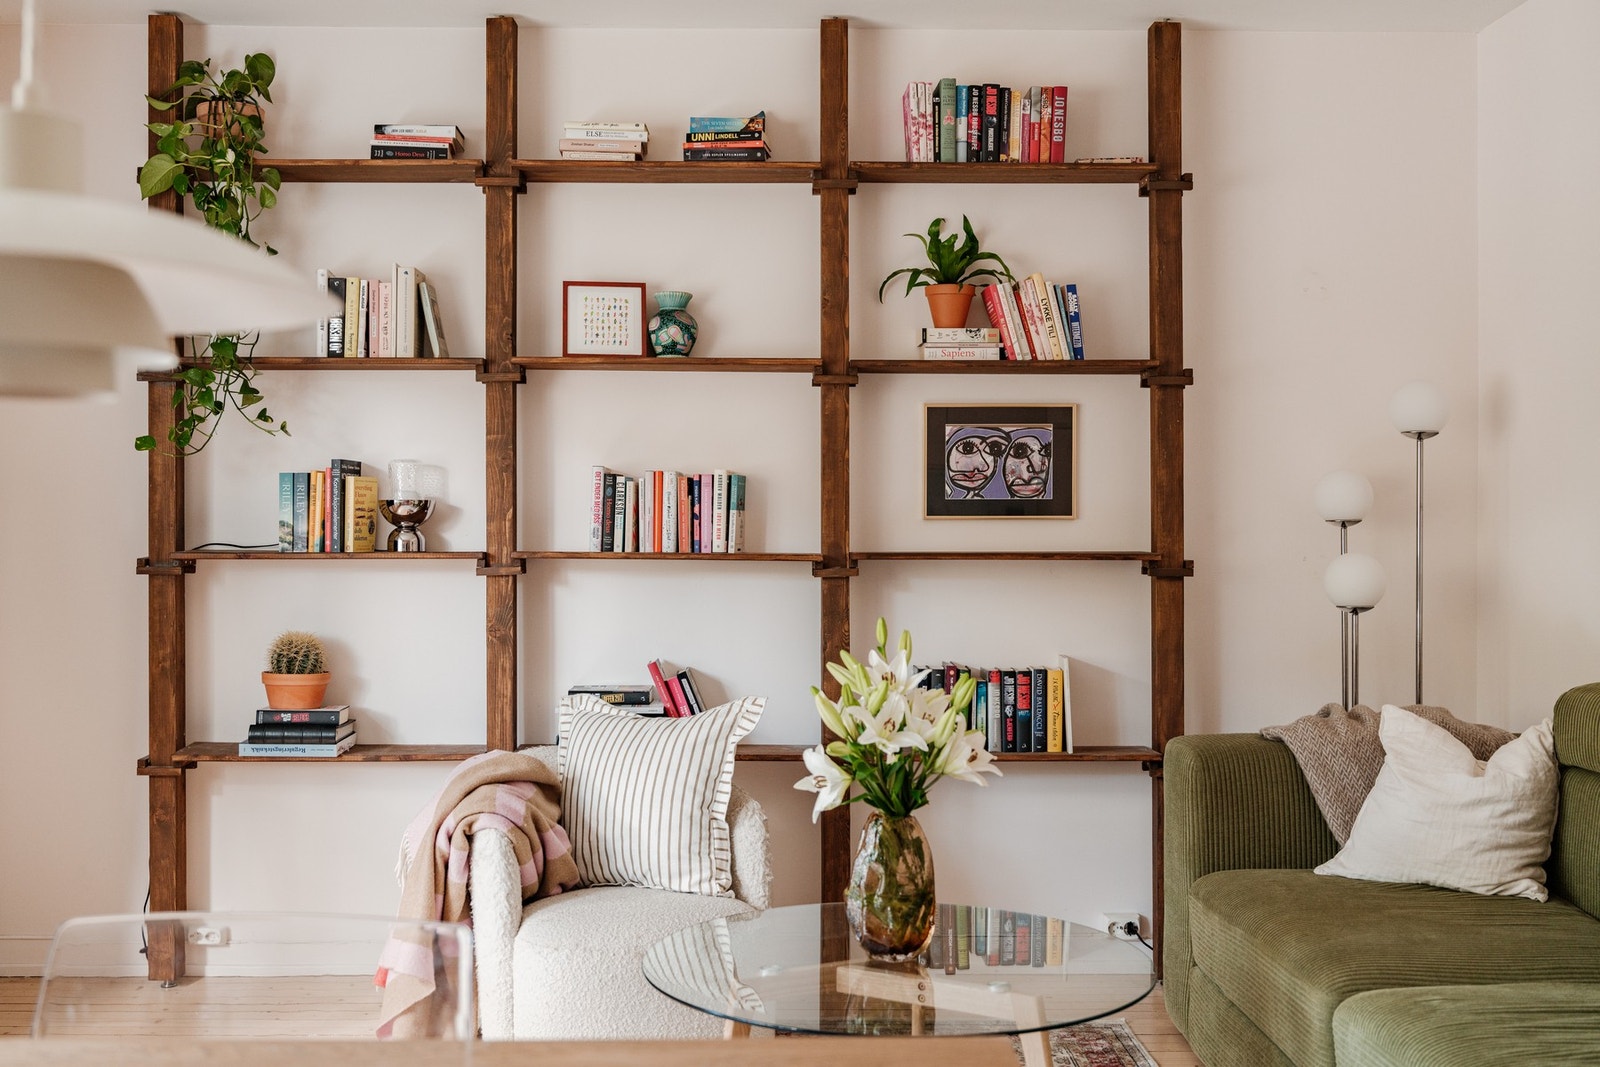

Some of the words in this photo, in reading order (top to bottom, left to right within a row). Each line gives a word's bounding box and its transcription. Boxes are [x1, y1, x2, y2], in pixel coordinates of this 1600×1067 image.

[972, 88, 979, 96] JO
[986, 86, 997, 95] JO
[1055, 96, 1065, 107] JO
[1053, 109, 1064, 142] NESBØ
[691, 133, 715, 141] UNNI
[1040, 298, 1053, 323] LYKKE
[1047, 325, 1056, 339] TIL!
[941, 349, 976, 360] Sapiens
[282, 484, 291, 514] RILEY
[296, 484, 305, 515] RILEY
[615, 482, 625, 516] CLARKSON
[332, 477, 340, 540] Konstruksjonselementer
[593, 501, 601, 512] MED
[1004, 676, 1015, 685] JO
[1017, 673, 1031, 684] JO
[1017, 685, 1031, 709] NESBØ
[251, 746, 306, 754] Reguleringsteknikk
